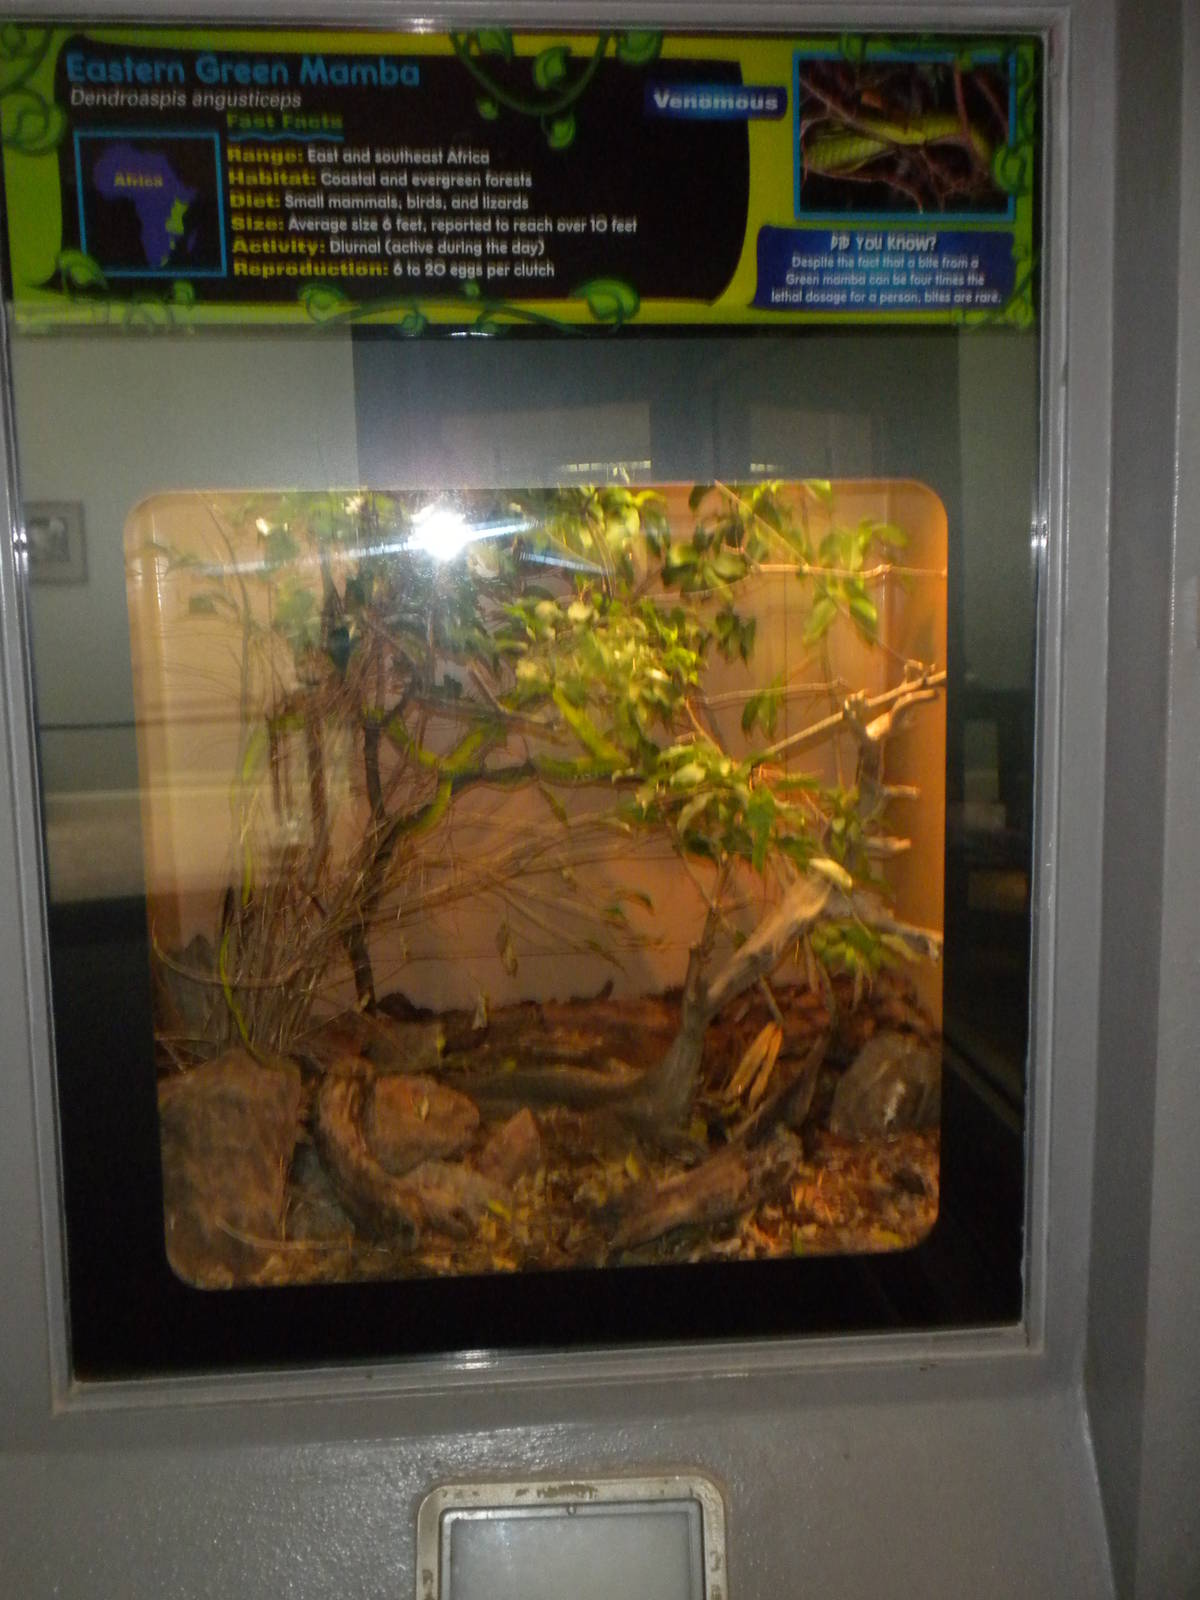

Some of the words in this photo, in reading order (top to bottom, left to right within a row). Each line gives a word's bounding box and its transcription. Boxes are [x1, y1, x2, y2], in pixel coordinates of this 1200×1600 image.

[66, 54, 184, 82] Eastern
[195, 55, 289, 84] Green
[300, 55, 420, 86] Mamba
[70, 88, 186, 110] Dendroaspis
[192, 89, 301, 110] angusticeps
[653, 88, 779, 110] Venomous
[227, 147, 303, 166] Range:
[308, 147, 338, 163] East
[343, 148, 370, 163] and
[375, 148, 443, 164] southeast
[447, 148, 490, 165] Africa
[114, 172, 163, 188] Africa
[228, 169, 316, 186] Habitat:
[321, 171, 376, 187] Coastal
[380, 171, 407, 187] and
[412, 173, 481, 190] evergreen
[485, 172, 532, 188] forests
[229, 193, 281, 209] Diet:
[285, 193, 324, 209] Small
[328, 193, 402, 211] mammals,
[407, 193, 447, 211] birds,
[451, 195, 478, 210] and
[483, 194, 529, 210] lizards
[231, 216, 284, 232] Size:
[288, 214, 347, 234] Average
[351, 216, 378, 232] size
[382, 216, 392, 232] 6
[396, 216, 427, 234] feet,
[431, 216, 491, 235] reported
[495, 217, 509, 232] to
[513, 216, 553, 233] reach
[557, 218, 587, 233] over
[590, 216, 608, 233] 10
[611, 216, 637, 233] feet
[232, 238, 325, 257] Activity:
[330, 239, 381, 254] Diurnal
[384, 239, 433, 256] (active
[438, 239, 482, 256] during
[486, 239, 508, 255] the
[511, 239, 545, 257] day)
[233, 261, 389, 279] Reproduction:
[393, 262, 403, 276] 6
[407, 263, 421, 276] to
[425, 262, 446, 276] 20
[450, 263, 483, 279] eggs
[486, 263, 511, 280] per
[513, 261, 555, 278] clutch
[792, 255, 834, 270] Despite
[837, 256, 854, 269] the
[857, 256, 880, 269] fact
[882, 256, 905, 269] that
[908, 257, 915, 269] a
[919, 256, 939, 269] bite
[942, 256, 967, 269] from
[971, 257, 979, 269] a
[786, 273, 819, 287] Green
[823, 273, 866, 287] mamba
[869, 274, 890, 287] can
[892, 273, 907, 287] be
[910, 273, 932, 287] four
[935, 273, 964, 287] times
[967, 273, 984, 287] the
[869, 293, 877, 304] a
